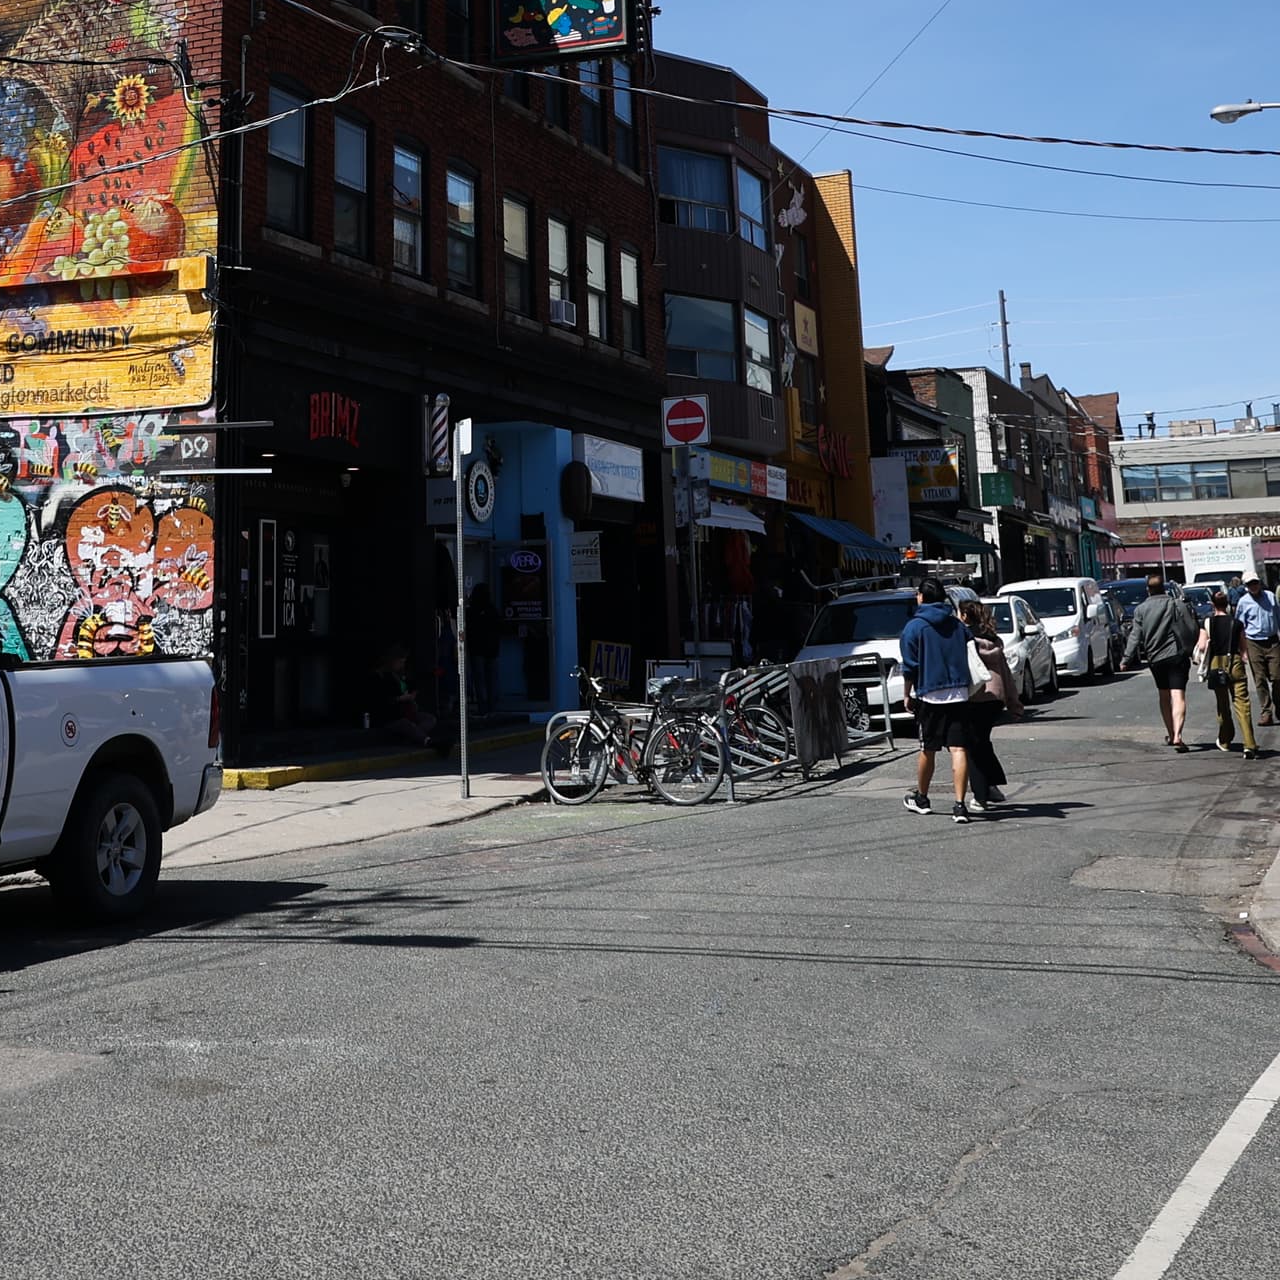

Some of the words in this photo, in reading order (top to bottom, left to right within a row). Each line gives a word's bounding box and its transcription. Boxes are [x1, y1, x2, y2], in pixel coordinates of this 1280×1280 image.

[6, 326, 135, 354] COMMUNITY
[923, 488, 952, 499] VITAMIN
[1217, 527, 1245, 538] MEAT
[592, 642, 630, 681] ATM
